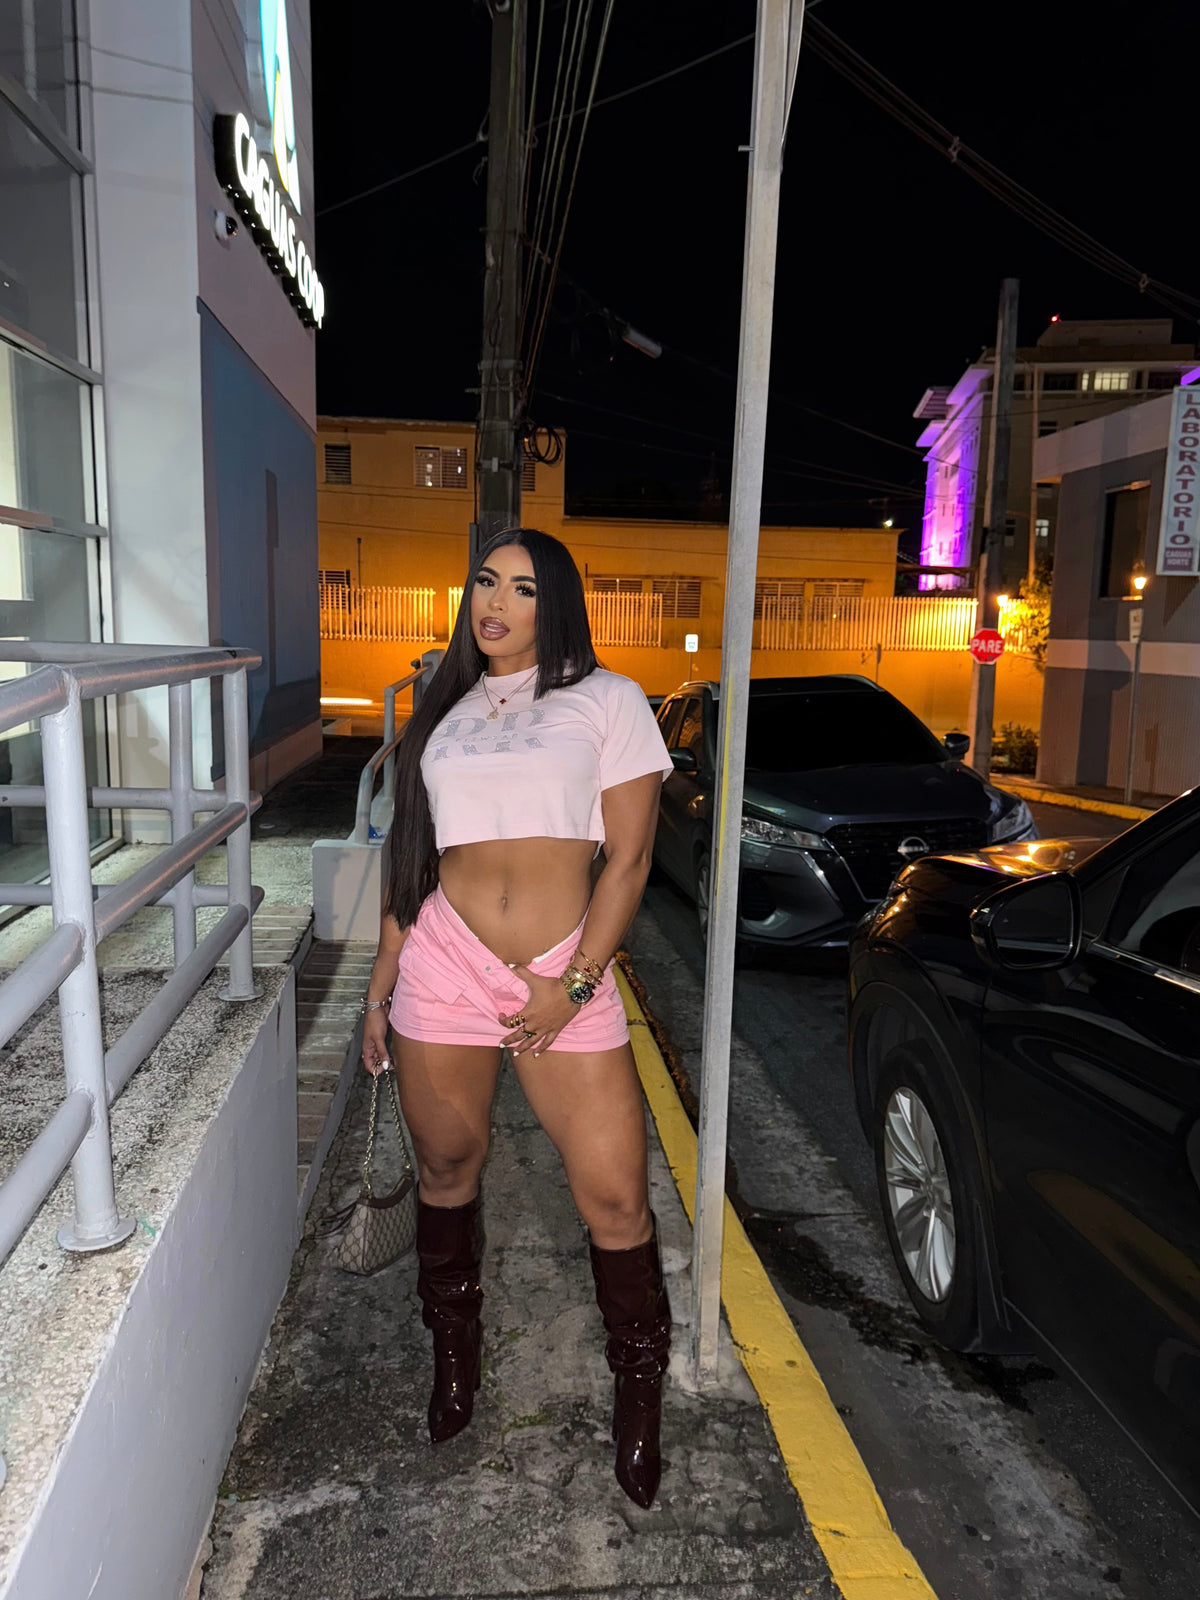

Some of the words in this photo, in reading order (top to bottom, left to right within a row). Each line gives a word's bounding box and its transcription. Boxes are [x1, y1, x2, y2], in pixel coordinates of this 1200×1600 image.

[234, 112, 296, 278] CAGUAS
[297, 240, 325, 330] COOP
[1169, 393, 1200, 546] LABORATORIO
[970, 638, 1003, 654] PARE
